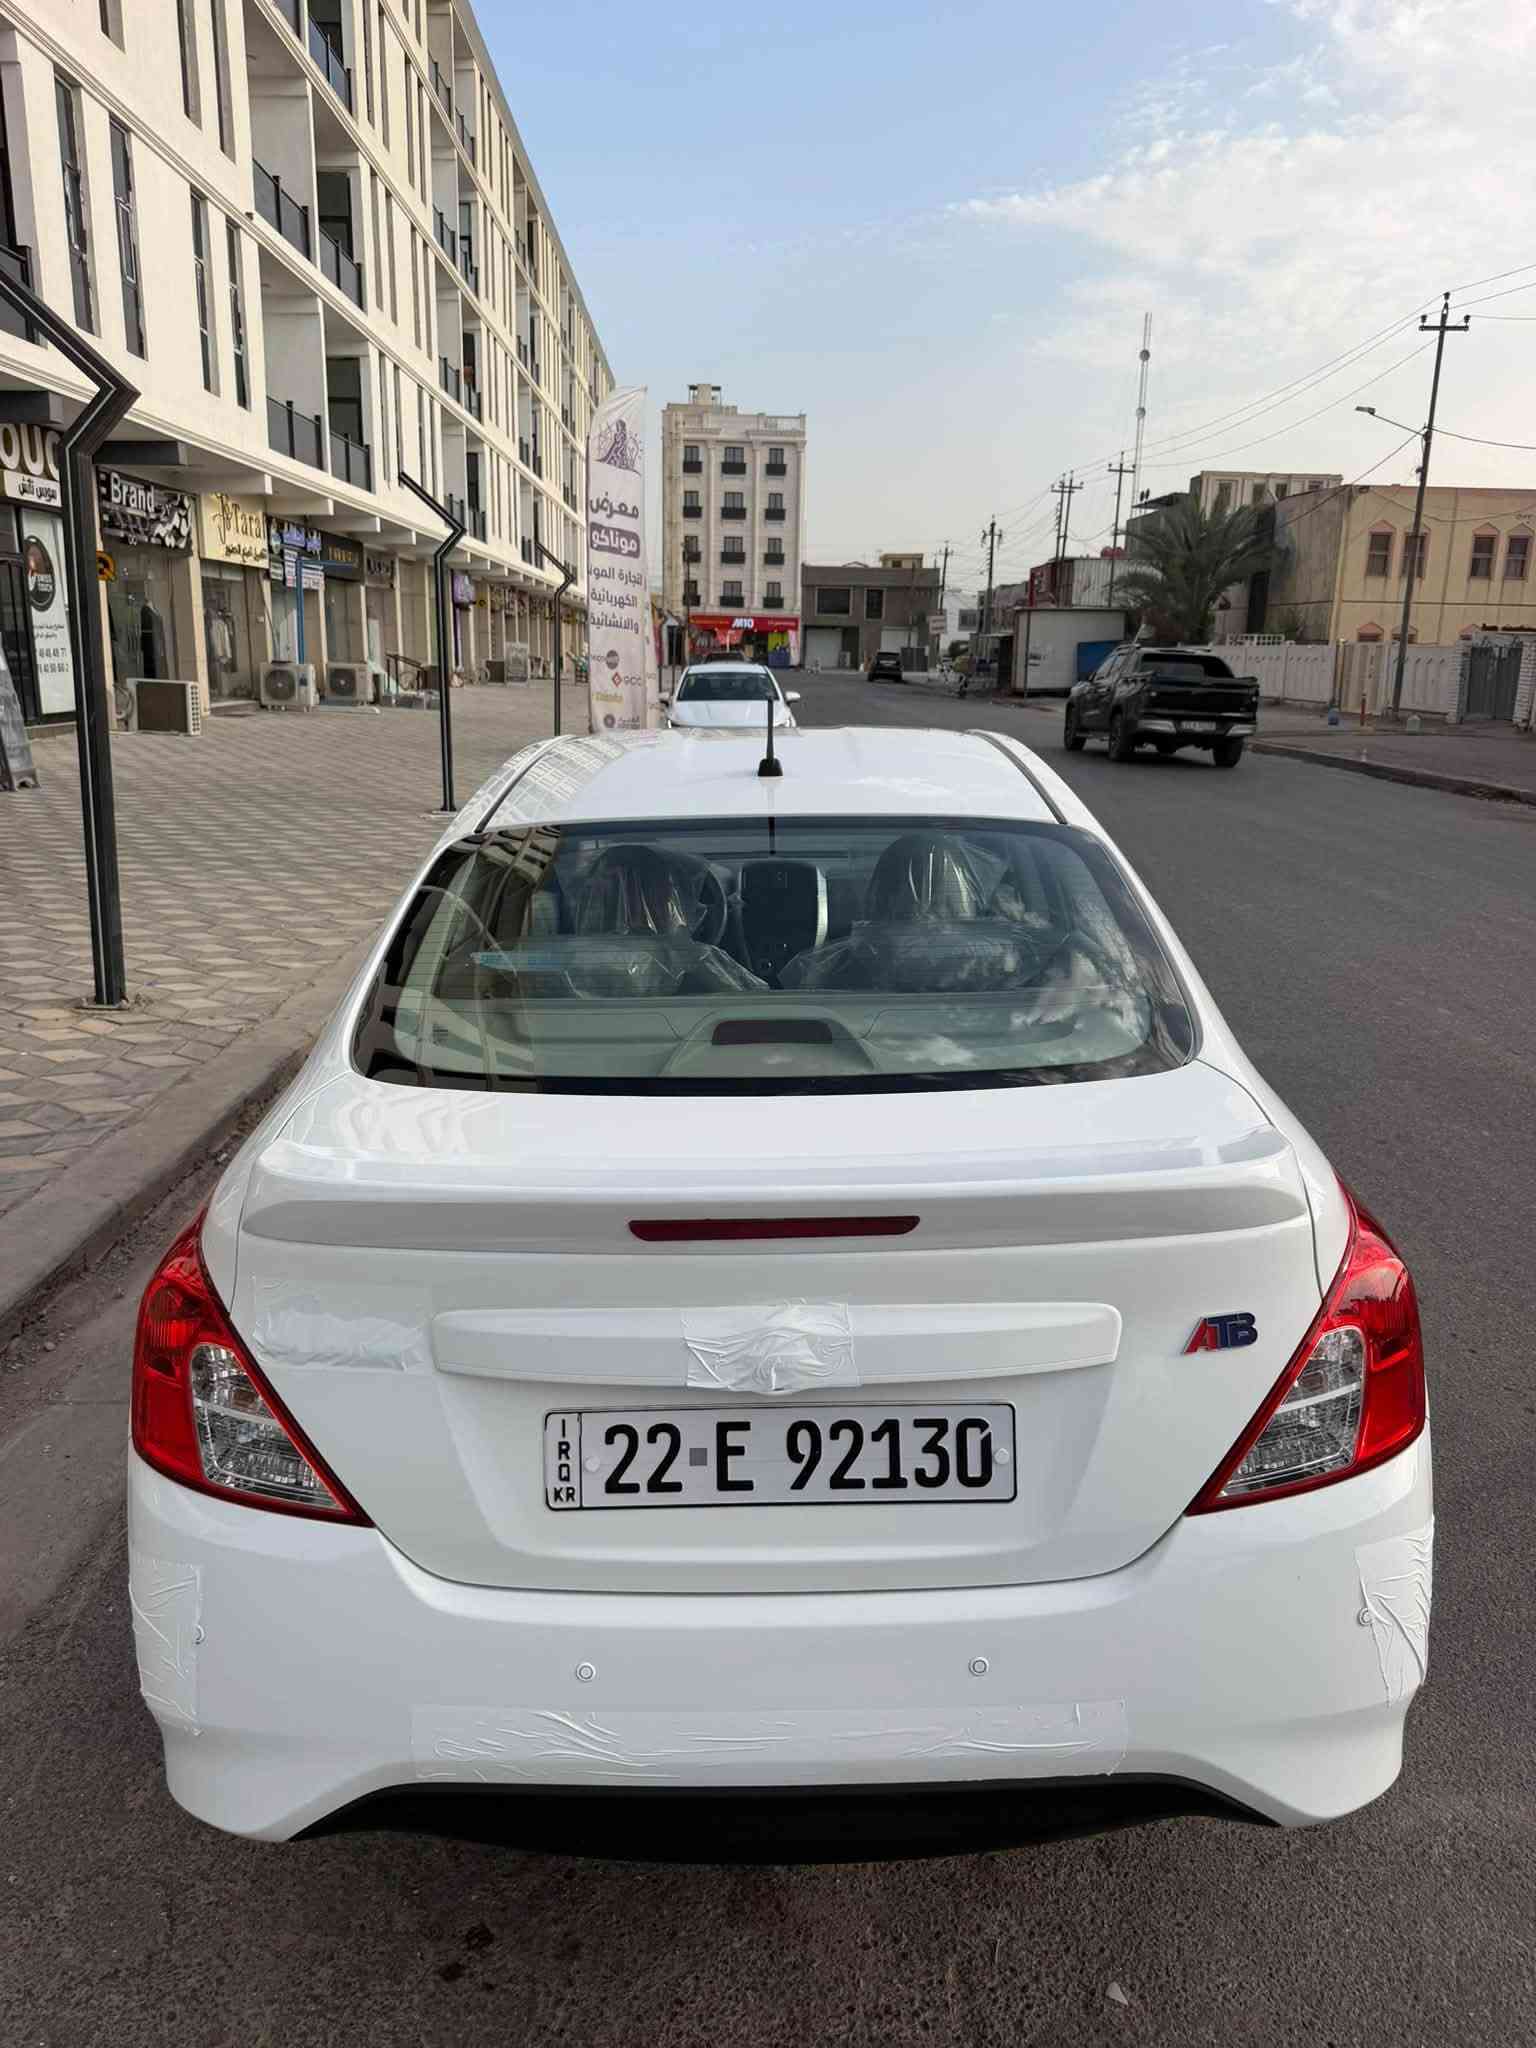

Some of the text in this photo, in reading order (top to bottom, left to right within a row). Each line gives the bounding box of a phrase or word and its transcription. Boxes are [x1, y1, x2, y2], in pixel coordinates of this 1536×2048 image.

[111, 471, 155, 513] Brand
[590, 491, 640, 519] معرض
[591, 529, 639, 554] موناكو
[1182, 1312, 1258, 1355] ATB
[605, 1417, 994, 1494] 22 E 92130
